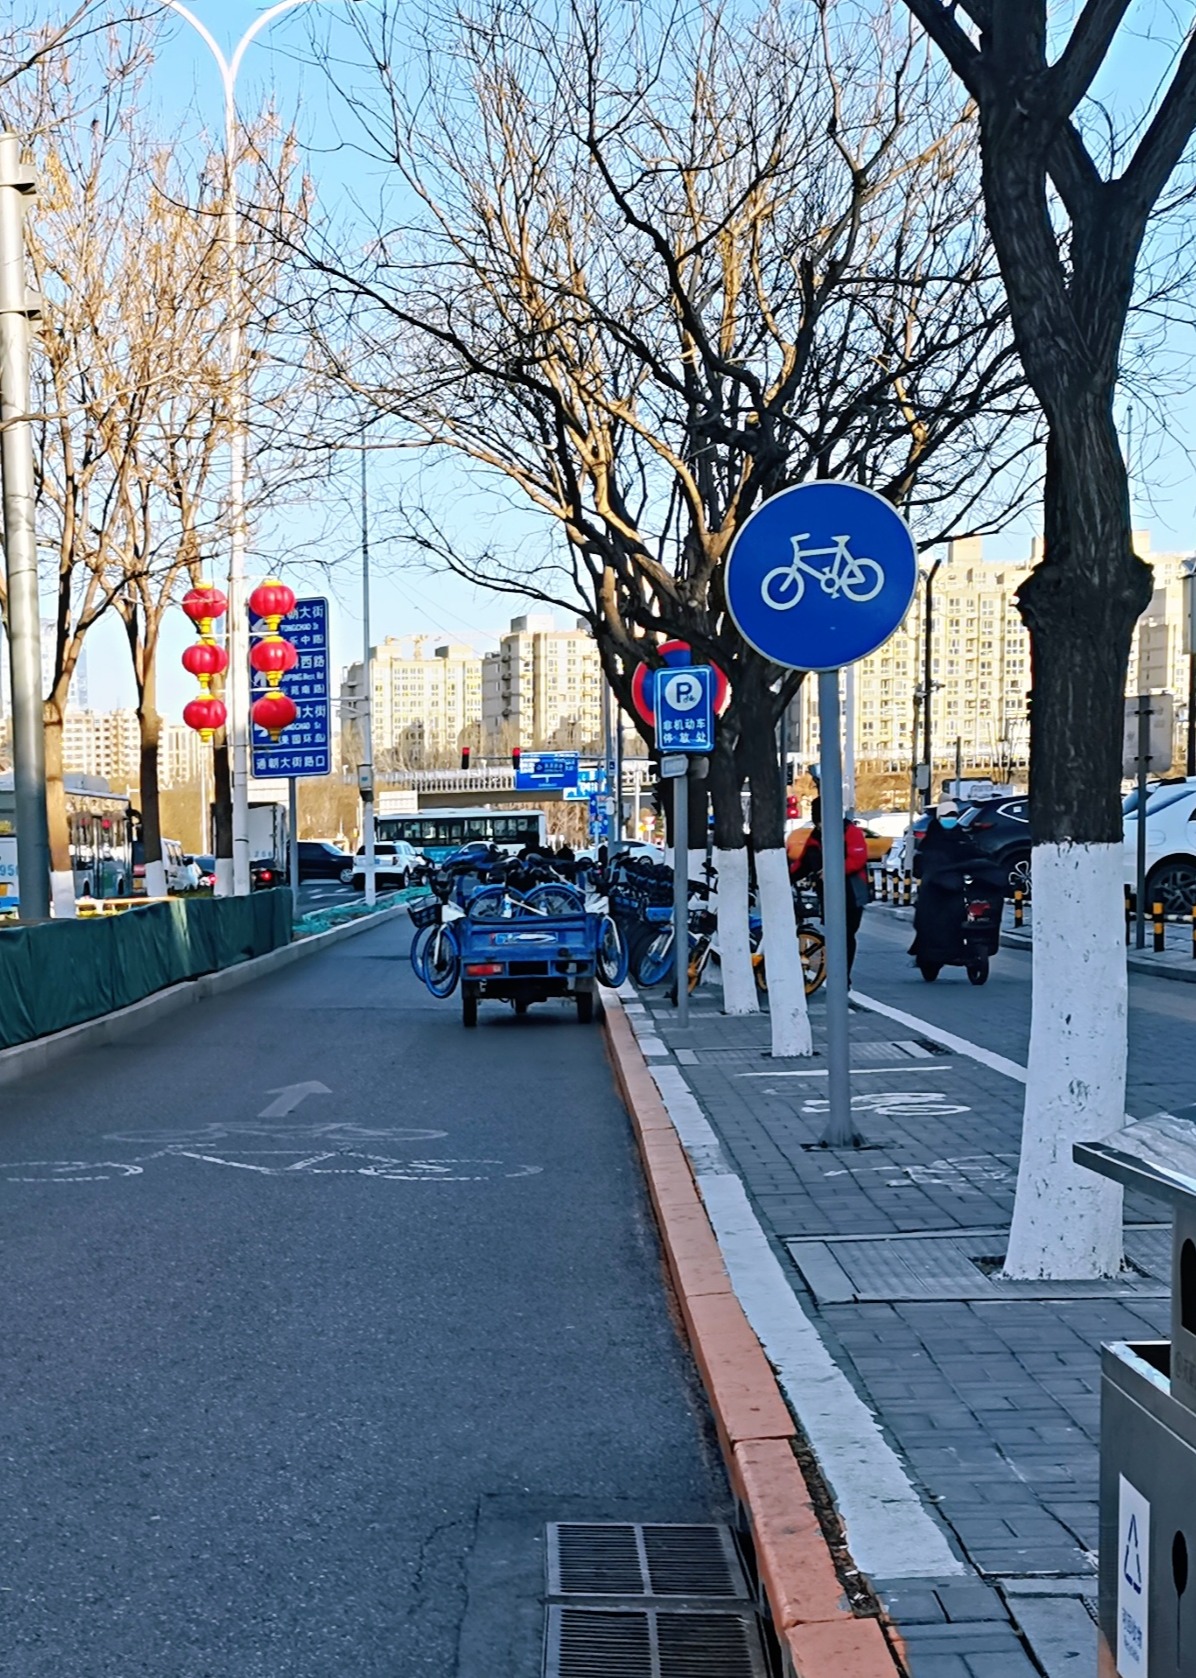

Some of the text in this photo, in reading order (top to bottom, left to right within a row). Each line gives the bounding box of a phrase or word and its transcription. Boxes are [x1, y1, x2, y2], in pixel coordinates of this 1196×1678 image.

[256, 755, 325, 770] 通朝大街路口
